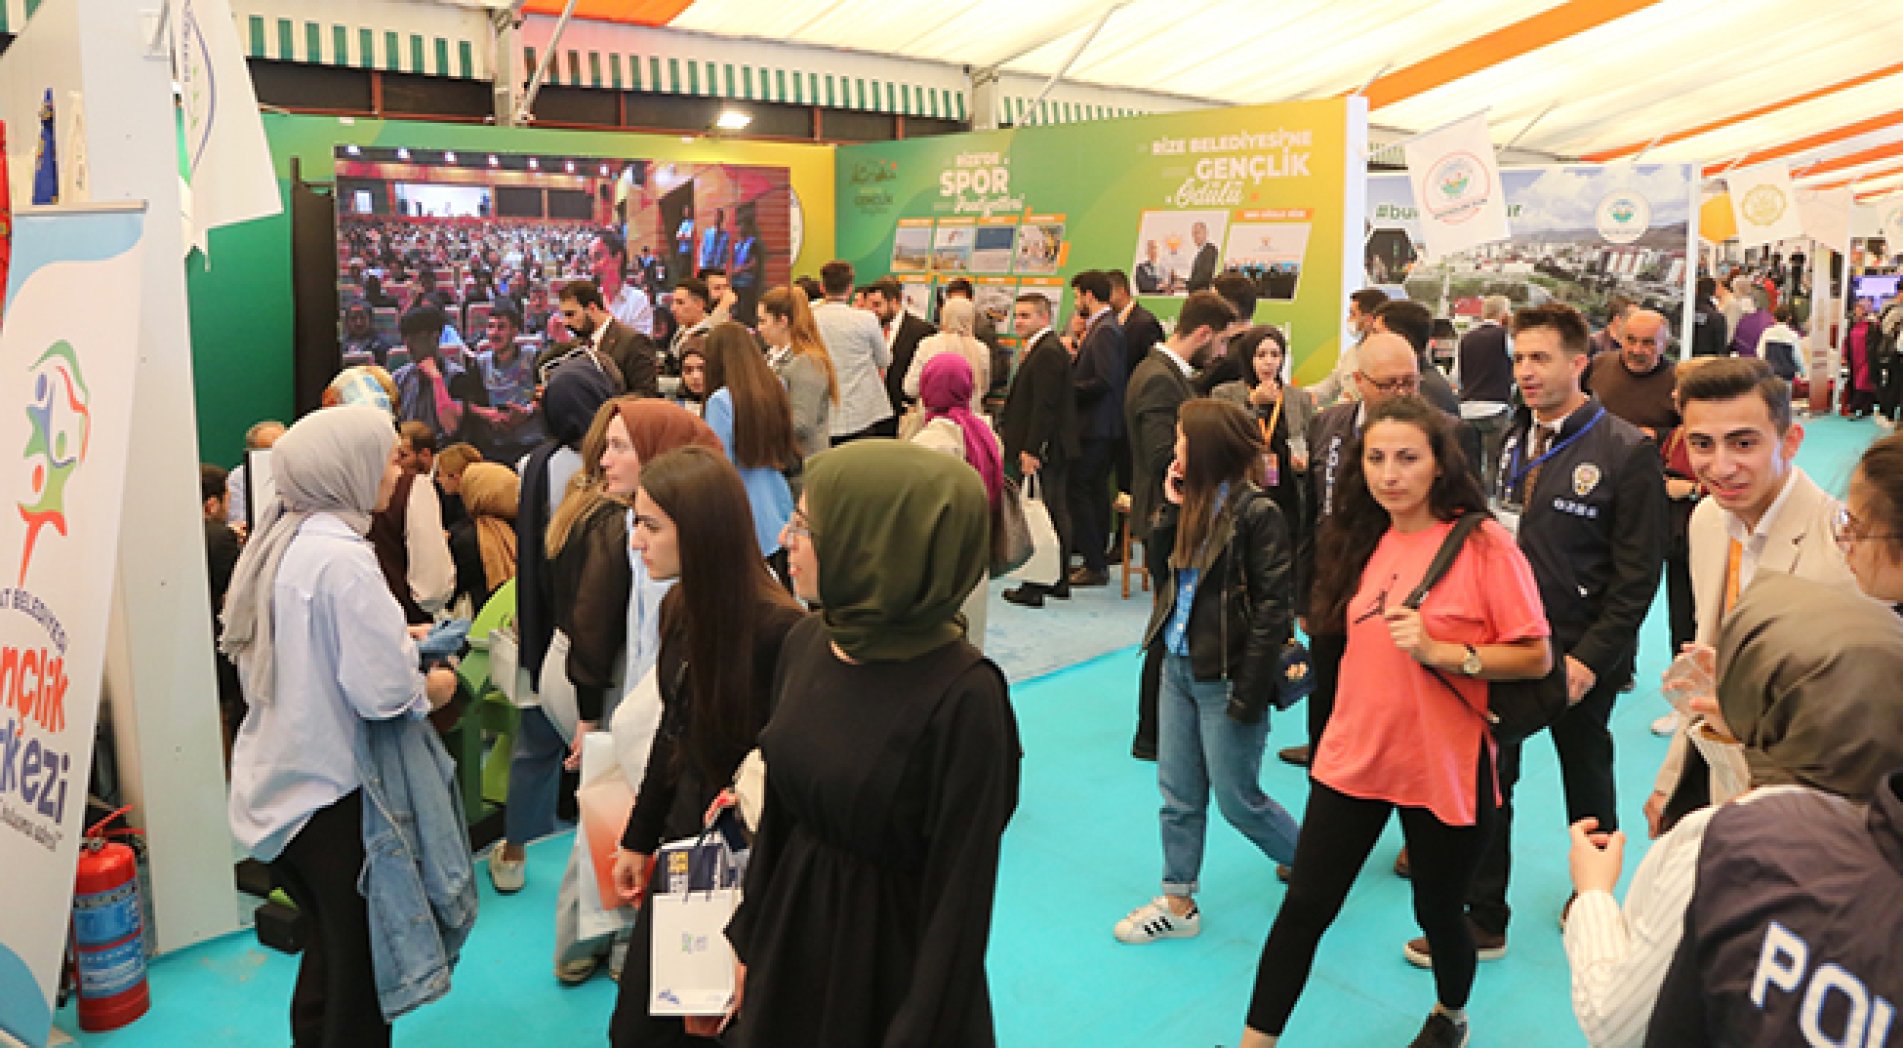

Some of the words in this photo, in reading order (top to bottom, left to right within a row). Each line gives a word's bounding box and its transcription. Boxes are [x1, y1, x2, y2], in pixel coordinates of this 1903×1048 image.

[940, 167, 1008, 197] SPOR
[1196, 146, 1311, 185] GENÇLİK
[0, 646, 70, 736] nçlik
